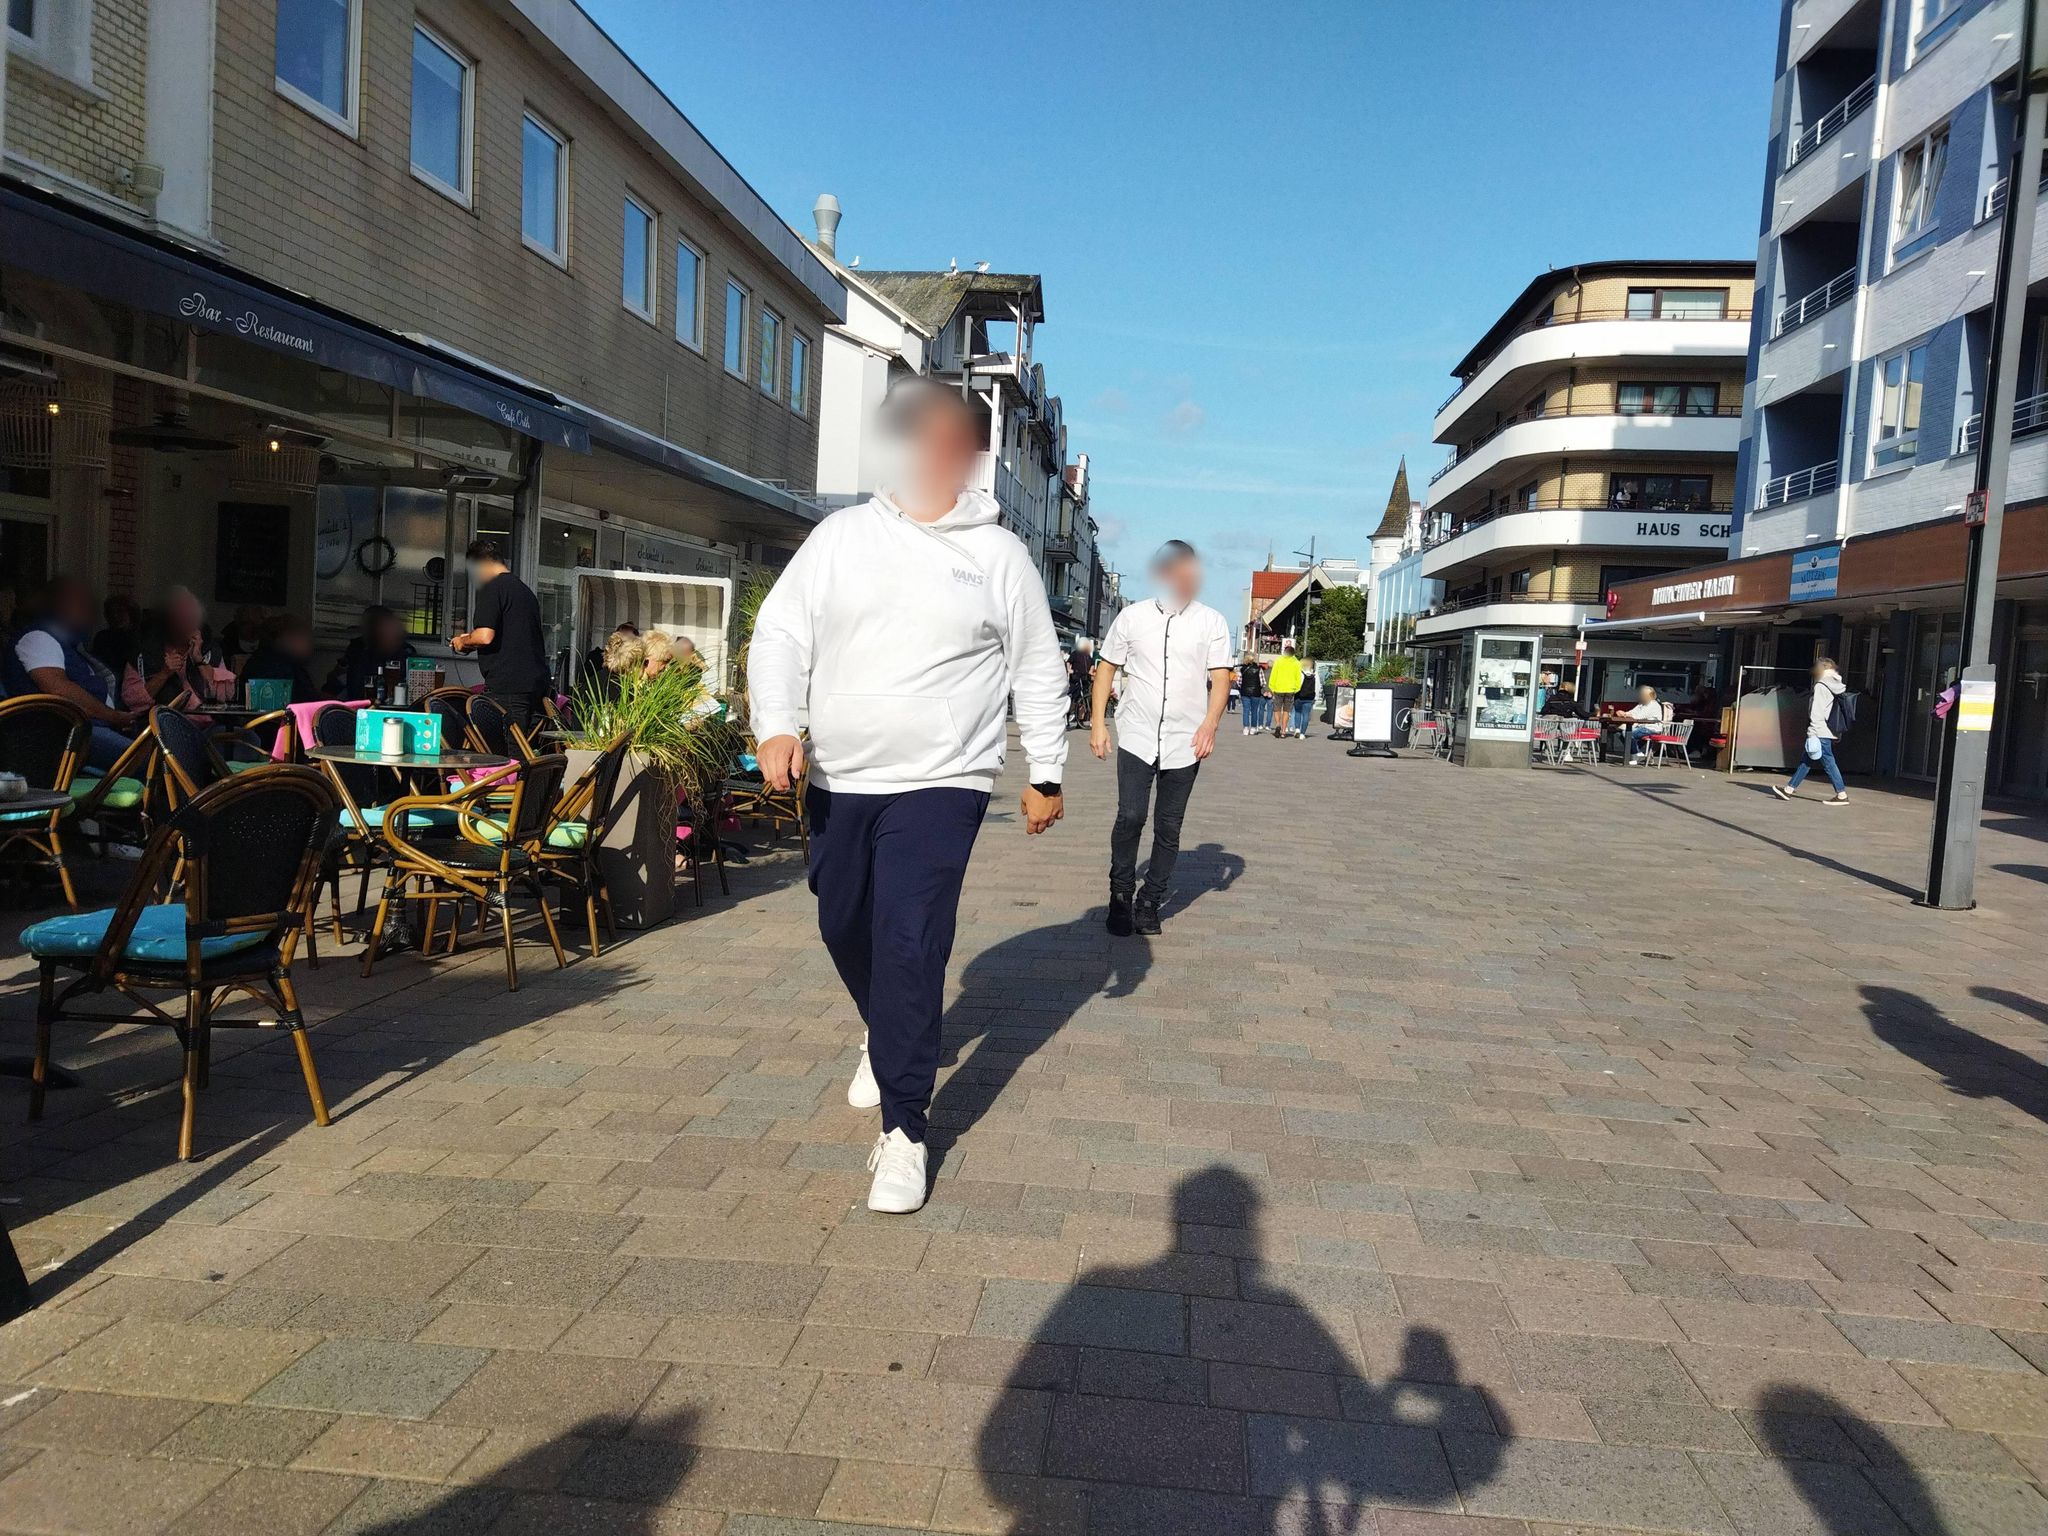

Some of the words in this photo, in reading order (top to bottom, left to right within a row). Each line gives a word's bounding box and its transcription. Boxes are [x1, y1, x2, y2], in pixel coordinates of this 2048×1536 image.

[179, 292, 221, 322] Bar
[235, 311, 314, 353] Restaurant
[1637, 522, 1680, 536] HAUS
[1700, 524, 1731, 538] SCH
[951, 567, 984, 585] VANS
